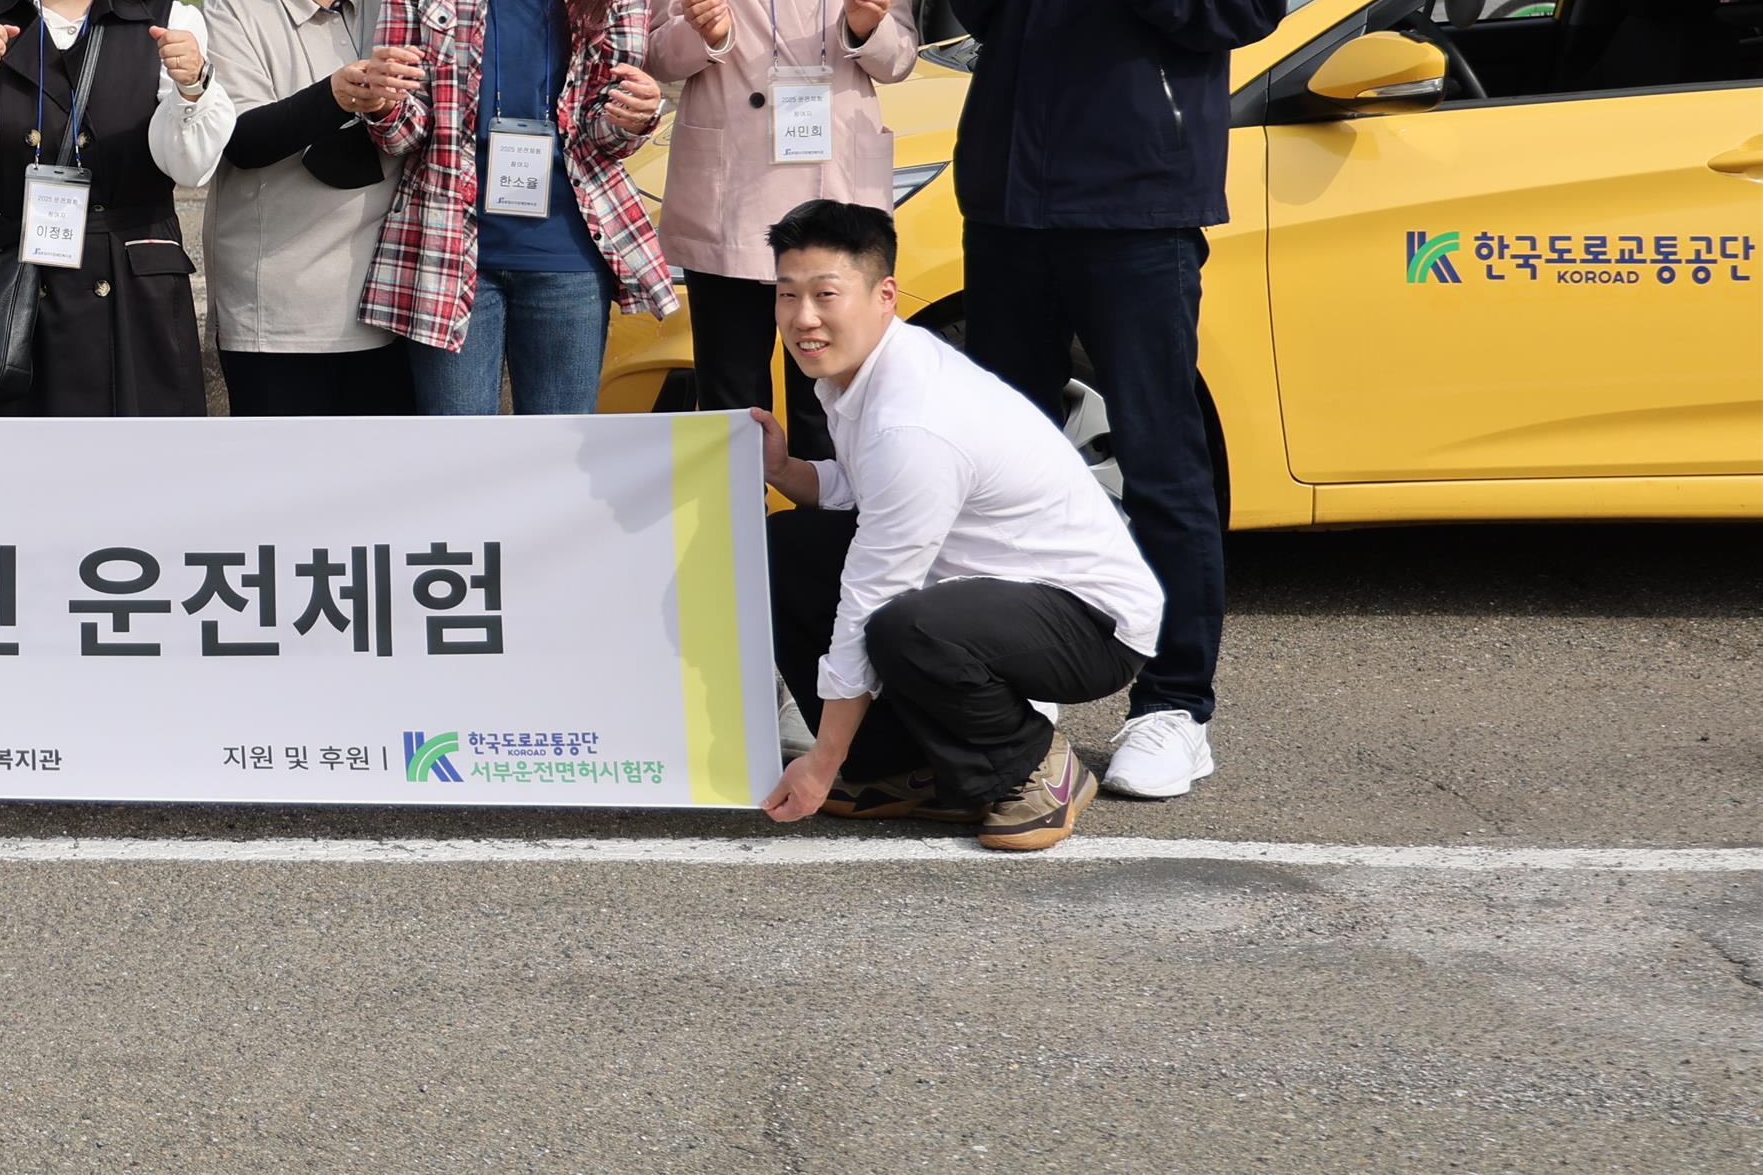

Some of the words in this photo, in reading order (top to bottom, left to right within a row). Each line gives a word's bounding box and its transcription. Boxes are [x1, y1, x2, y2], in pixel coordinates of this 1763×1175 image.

[785, 125, 822, 138] 서민희
[36, 225, 74, 241] 이정화
[1474, 231, 1756, 284] 한국도로교통공단
[1557, 270, 1640, 284] KOROAD
[67, 541, 505, 657] 운전체험
[467, 730, 599, 756] 한국도로교통공단
[507, 748, 547, 757] KOROAD
[222, 744, 274, 770] 지원
[283, 746, 308, 771] 및
[318, 745, 370, 772] 후원
[470, 759, 665, 785] 서부운전면허시험장
